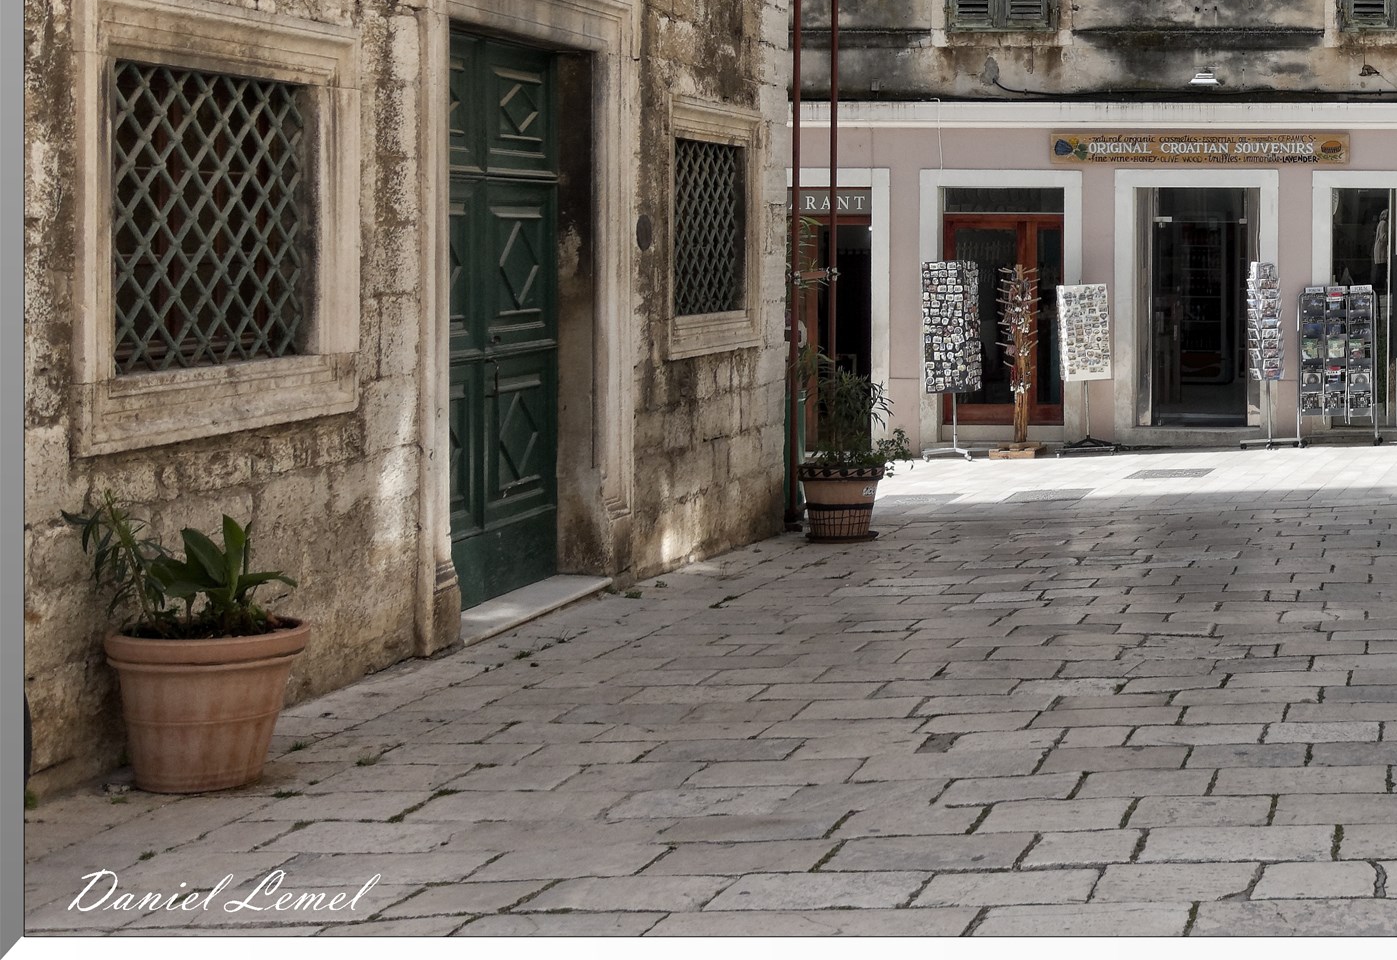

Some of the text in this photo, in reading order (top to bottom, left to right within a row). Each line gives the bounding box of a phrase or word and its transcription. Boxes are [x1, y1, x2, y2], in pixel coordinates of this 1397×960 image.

[1124, 136, 1156, 146] organic
[1159, 135, 1198, 143] cosmetics
[1089, 142, 1313, 154] ORIGINAL CROATIAN SOUVENIRS
[1091, 153, 1107, 163] fine
[1133, 155, 1157, 163] HONEY
[1208, 154, 1238, 163] truffles
[788, 196, 866, 210] RANT
